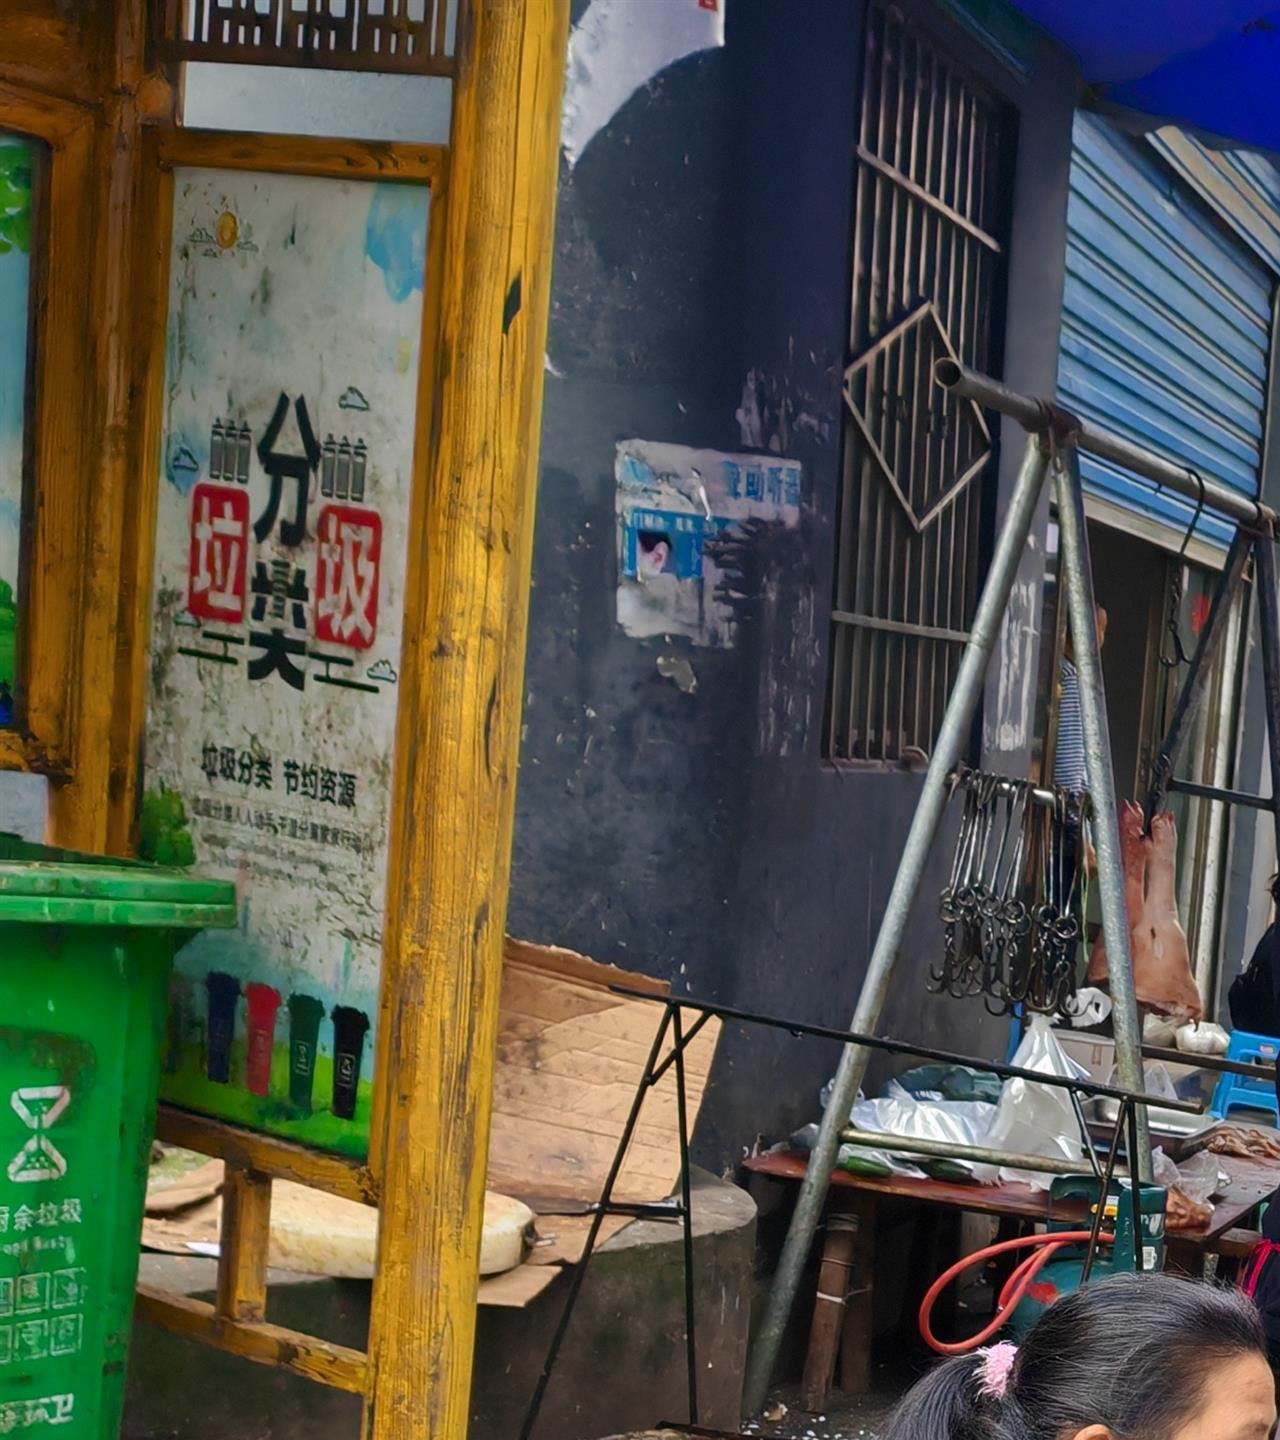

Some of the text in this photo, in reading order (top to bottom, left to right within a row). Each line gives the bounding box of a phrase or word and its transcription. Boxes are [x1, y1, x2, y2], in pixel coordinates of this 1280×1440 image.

[201, 742, 357, 808] 垃圾分类 节约资源
